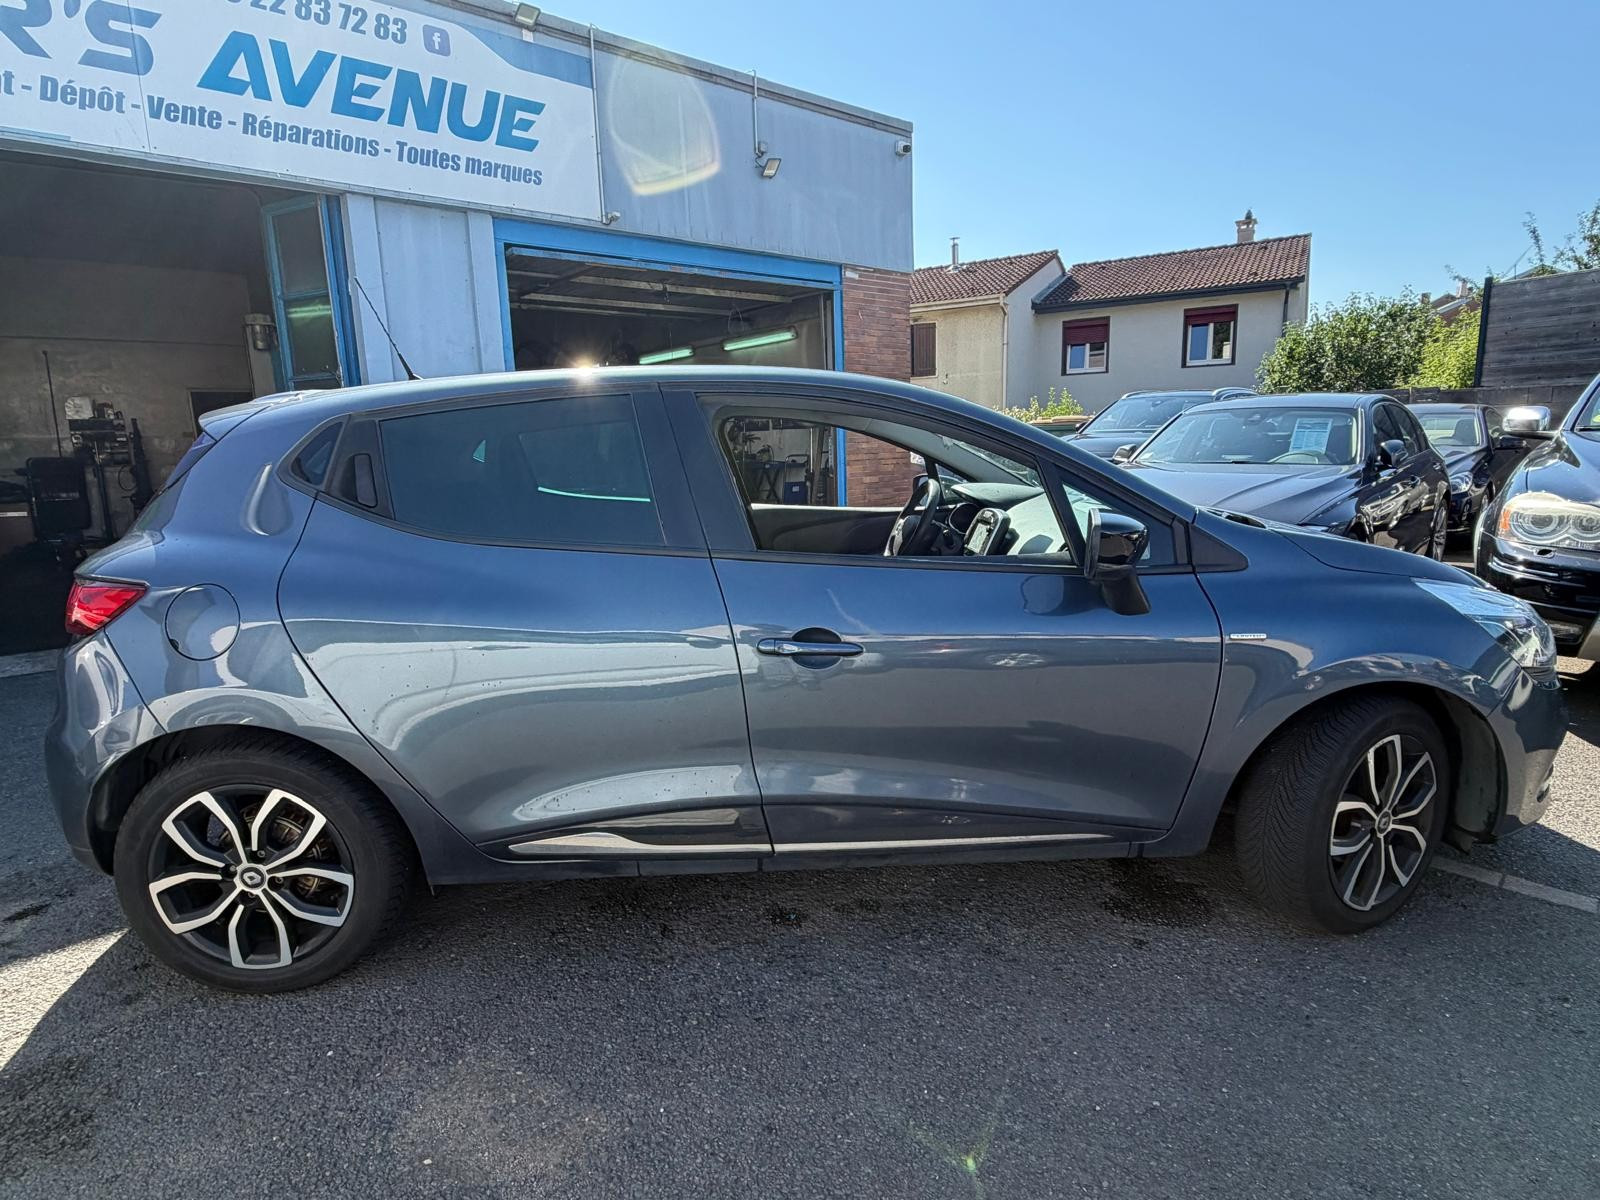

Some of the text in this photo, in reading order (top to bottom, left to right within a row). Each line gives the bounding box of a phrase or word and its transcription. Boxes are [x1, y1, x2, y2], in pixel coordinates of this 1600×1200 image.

[295, 0, 331, 25] 83
[339, 3, 368, 35] 72
[374, 13, 407, 44] 83
[40, 75, 126, 114] Dépôt
[147, 95, 223, 129] Vente
[242, 112, 380, 157] Réparations
[396, 140, 461, 171] Toutes
[464, 156, 543, 186] marques
[196, 30, 546, 152] AVENUE
